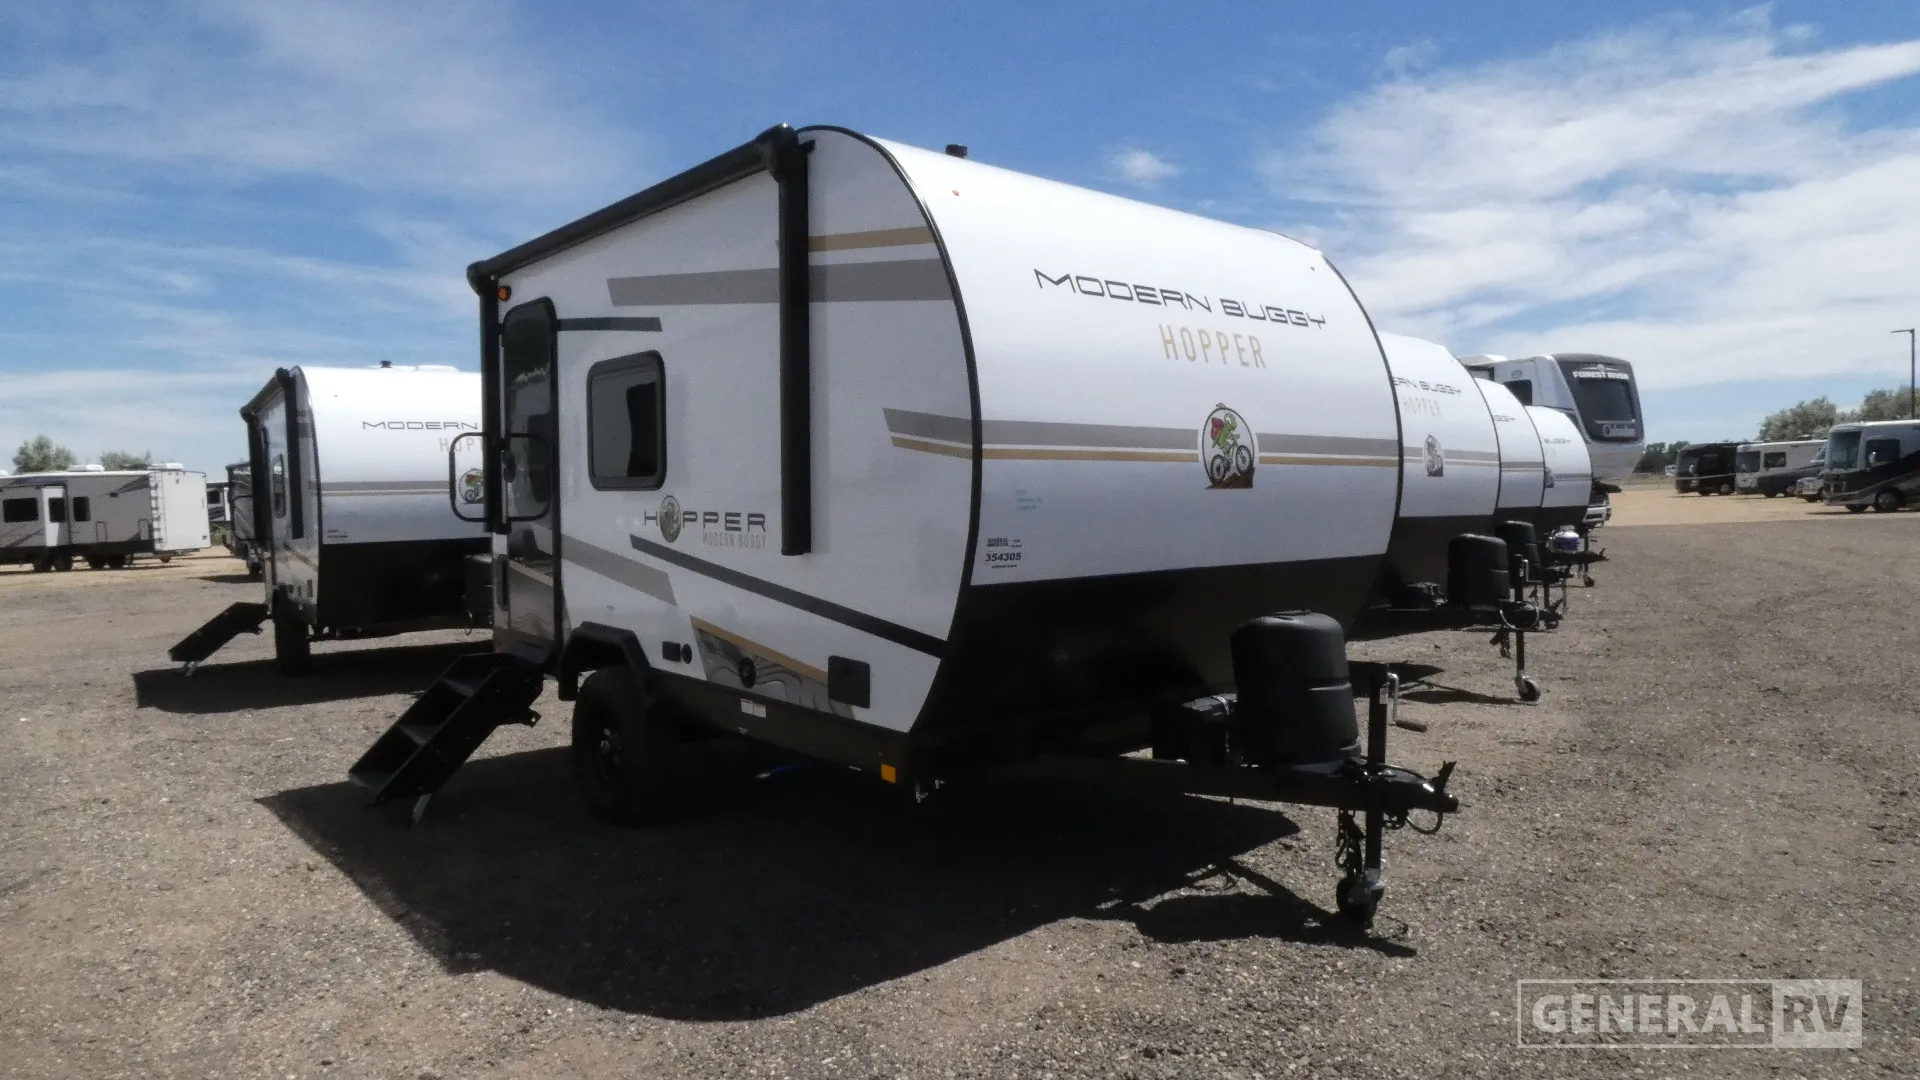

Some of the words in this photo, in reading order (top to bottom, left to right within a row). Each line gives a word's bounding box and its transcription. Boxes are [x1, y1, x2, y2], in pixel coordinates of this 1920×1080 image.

[1033, 267, 1212, 314] MODERN
[1220, 297, 1327, 330] BUGGY
[1158, 323, 1267, 369] HOPPER
[1572, 371, 1606, 379] FOREST
[1419, 380, 1462, 396] BUGGY
[361, 421, 478, 431] MODERN
[985, 552, 1022, 562] 354305
